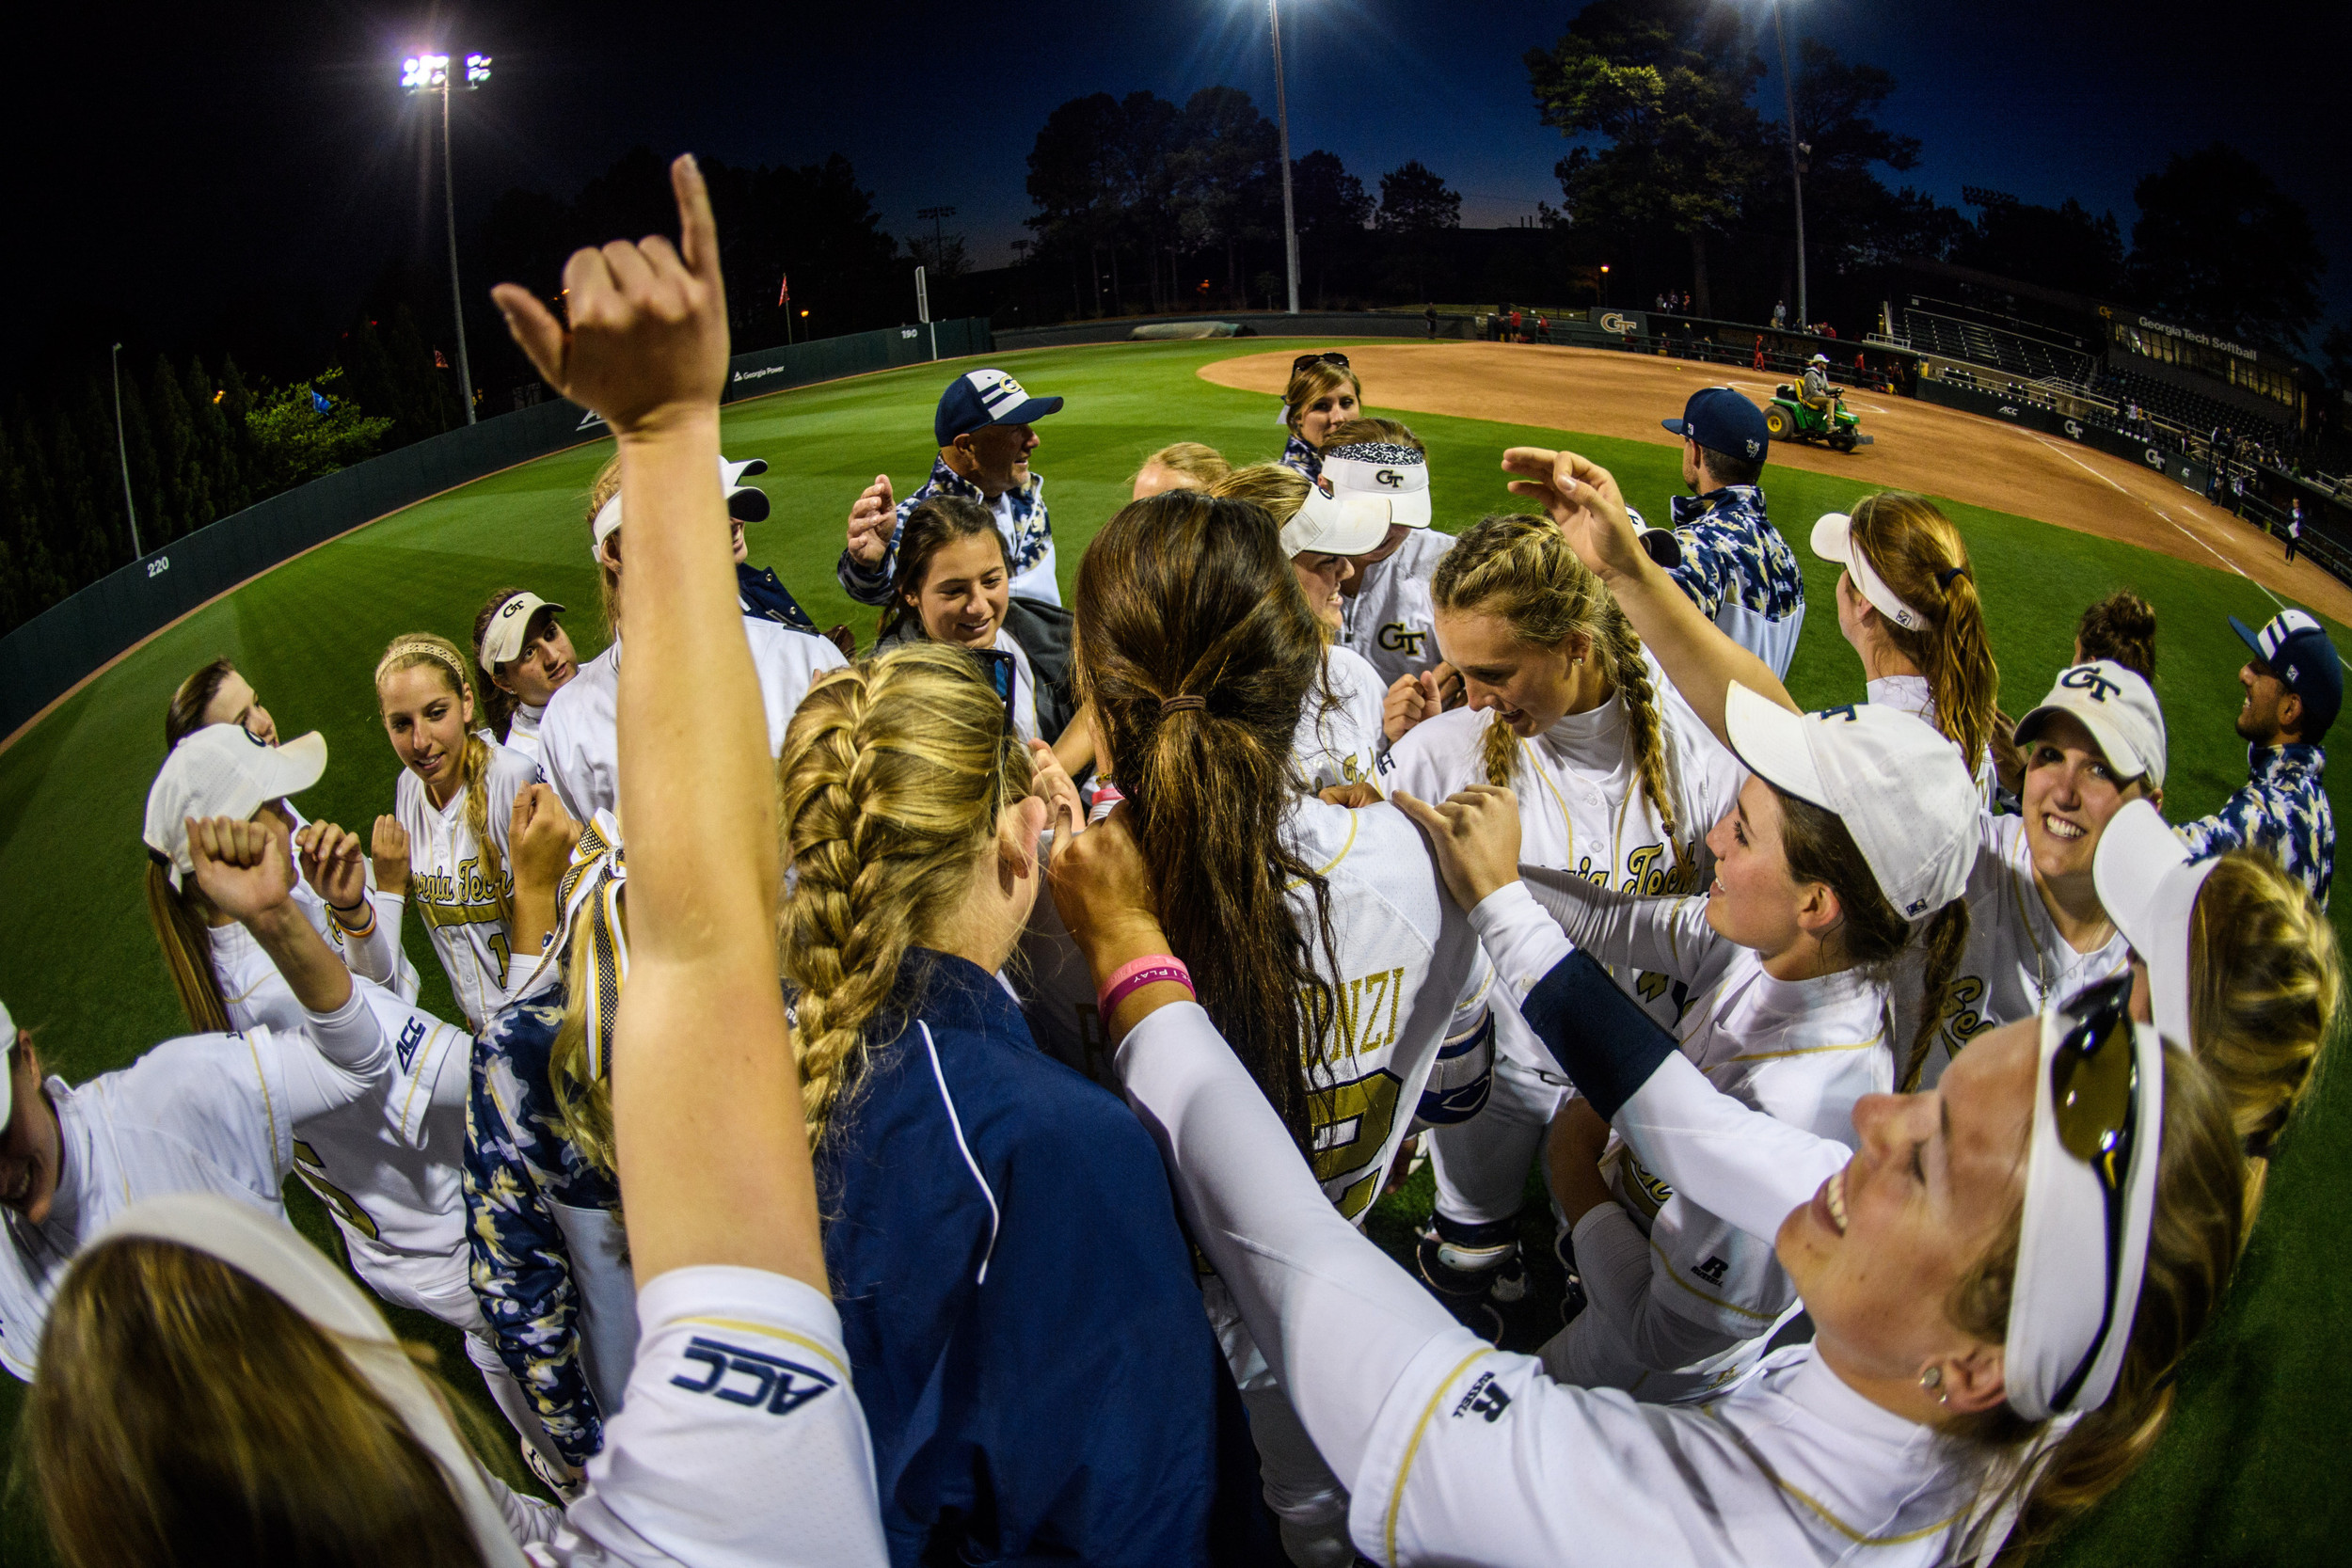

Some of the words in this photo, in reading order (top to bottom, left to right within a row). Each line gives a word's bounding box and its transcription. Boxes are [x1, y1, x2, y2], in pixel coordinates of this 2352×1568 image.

[901, 329, 918, 339] 190
[1600, 312, 1636, 335] GT
[2138, 316, 2182, 337] Georgia
[2182, 328, 2209, 345] Tech
[2212, 337, 2257, 361] Softball
[743, 369, 766, 379] Georgia
[767, 366, 785, 374] Power
[1998, 406, 2019, 416] ACC
[2064, 420, 2083, 439] GT
[2146, 449, 2165, 469] GT
[1375, 469, 1404, 488] GT
[147, 556, 169, 578] 220
[502, 600, 524, 618] GT
[1377, 622, 1426, 656] GT
[2061, 666, 2121, 703] GT
[1134, 969, 1168, 983] PLAY
[396, 1016, 426, 1075] ACC
[669, 1336, 837, 1416] ACC
[1452, 1371, 1495, 1418] RUSSELL
